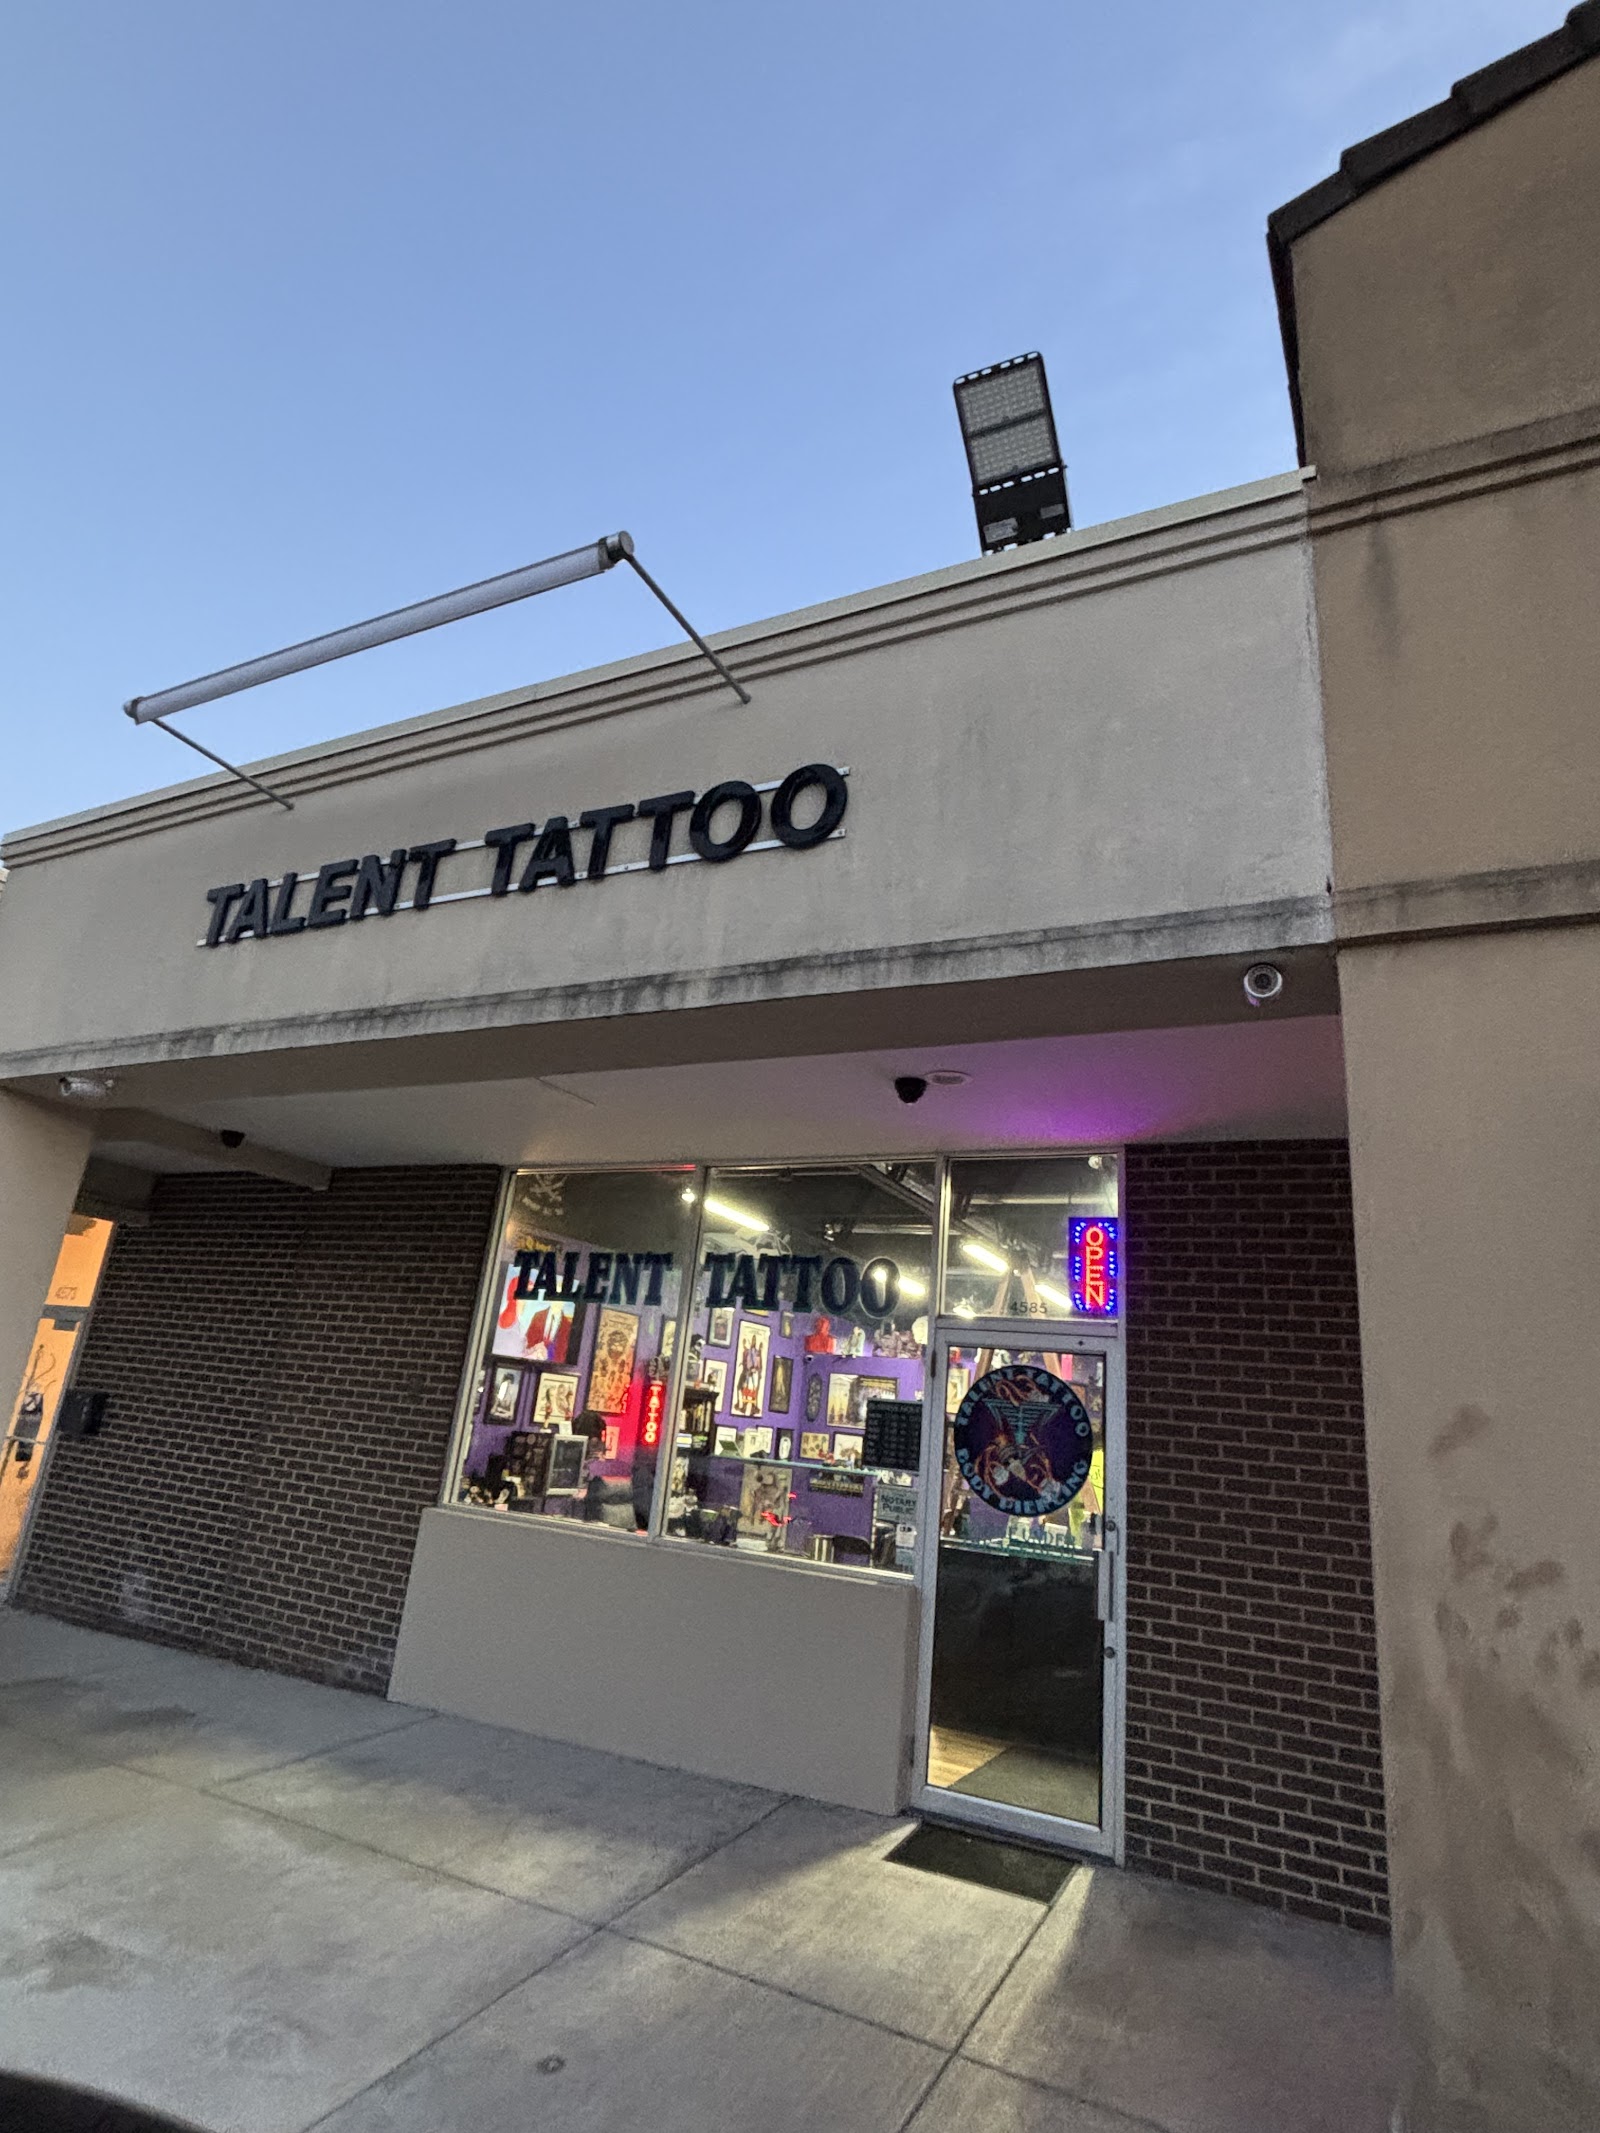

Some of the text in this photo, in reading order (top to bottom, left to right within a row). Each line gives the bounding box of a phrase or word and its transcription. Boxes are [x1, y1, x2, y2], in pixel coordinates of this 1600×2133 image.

[205, 763, 849, 947] TALENT TATTOO
[514, 1251, 901, 1319] TALENT TATTOO
[1085, 1226, 1104, 1306] OPEN
[1010, 1301, 1048, 1314] 4585
[645, 1385, 662, 1443] TATTOO
[957, 1368, 1090, 1437] TALENT TATTOO
[881, 1494, 917, 1508] NOTARY
[882, 1503, 915, 1516] PUBLIC
[956, 1447, 994, 1499] BODY
[998, 1460, 1088, 1514] PIERCING
